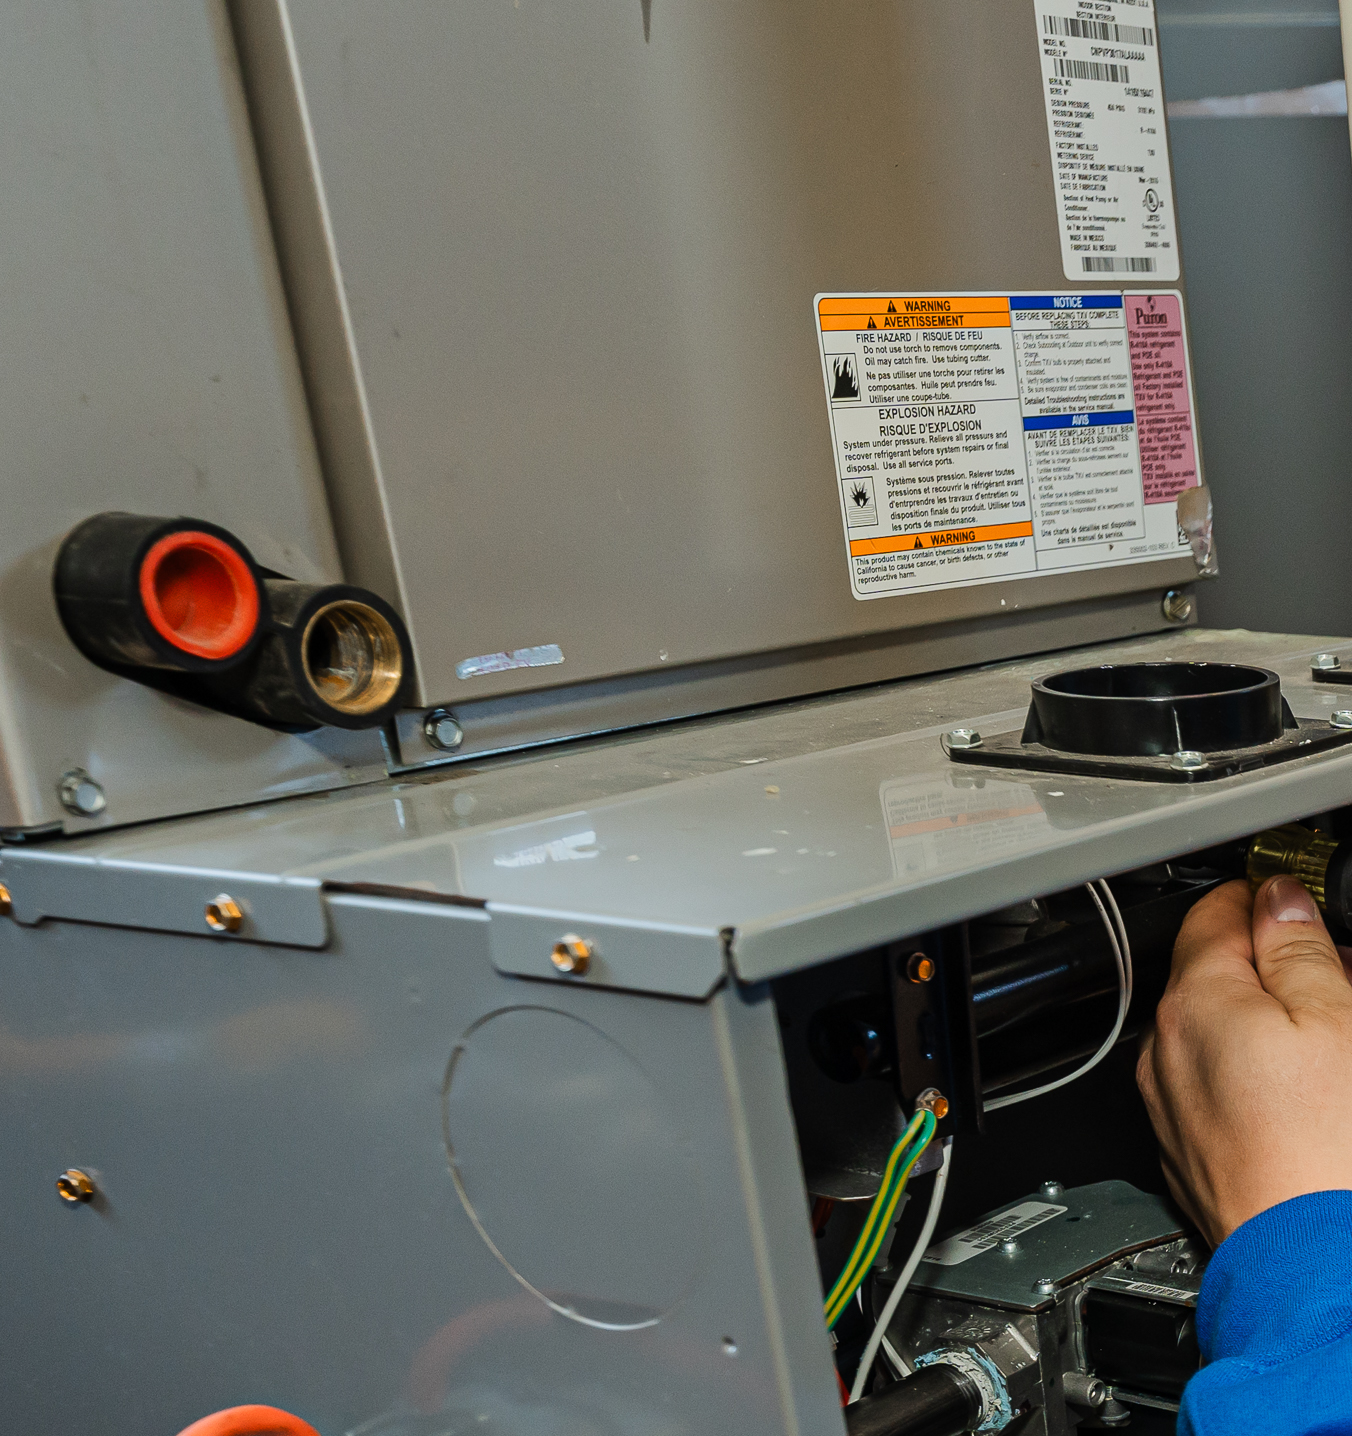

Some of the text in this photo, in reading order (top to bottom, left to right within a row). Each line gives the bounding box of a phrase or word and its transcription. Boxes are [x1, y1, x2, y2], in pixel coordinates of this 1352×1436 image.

[904, 301, 951, 311] WARNING
[1054, 297, 1082, 308] NOTICE
[884, 315, 964, 327] AVERTISSEMENT
[1136, 308, 1167, 324] Puron
[856, 334, 874, 343] FIRE
[878, 333, 911, 342] HAZARD
[923, 332, 952, 341] RISQUE
[955, 331, 965, 340] DE
[968, 331, 983, 340] FEU
[864, 345, 873, 354] Do
[876, 345, 886, 353] not
[904, 344, 922, 353] torch
[924, 344, 931, 352] to
[933, 344, 957, 352] remove
[865, 357, 875, 365] Oil
[877, 358, 891, 367] may
[894, 356, 913, 365] catch
[915, 355, 928, 364] fire.
[932, 355, 945, 363] Use
[947, 354, 968, 365] tubing
[866, 366, 1005, 381] Ne pas utiliser une torche pour retirer les
[868, 379, 997, 392] composantes. Huile peut prendre feu.
[869, 395, 894, 403] Utiliser
[912, 392, 951, 403] coupe-tube.
[879, 404, 976, 420] EXPLOSION HAZARD
[1072, 415, 1089, 425] AVIS
[880, 420, 981, 436] RISQUE D'EXPLOSION
[843, 440, 870, 450] System
[872, 437, 893, 447] under
[895, 436, 927, 447] pressure.
[929, 435, 953, 444] Relieve
[965, 432, 994, 443] pressure
[996, 430, 1007, 439] and
[845, 453, 872, 461] recover
[874, 448, 910, 461] refrigerant
[912, 447, 934, 456] before
[936, 446, 960, 456] system
[962, 443, 985, 453] repairs
[995, 441, 1009, 450] final
[846, 463, 879, 474] disposal.
[883, 461, 896, 470] Use
[909, 458, 933, 468] service
[935, 457, 954, 468] ports.
[886, 475, 916, 487] Système
[918, 475, 935, 483] sous
[937, 472, 967, 484] pression.
[995, 468, 1015, 477] toutes
[888, 488, 921, 499] pressions
[924, 486, 930, 494] et
[932, 484, 962, 494] recouvrir
[964, 482, 969, 491] le
[1007, 478, 1024, 487] avant
[937, 494, 946, 504] les
[948, 492, 973, 502] travaux
[975, 489, 1009, 501] d'entretien
[890, 508, 928, 521] disposition
[930, 505, 948, 516] finale
[951, 504, 959, 513] du
[988, 501, 1010, 511] Utiliser
[1012, 499, 1026, 507] tous
[892, 516, 978, 532] les ports de maintenance.
[931, 531, 975, 546] WARNING
[856, 558, 869, 566] This
[871, 555, 895, 566] product
[897, 555, 910, 563] may
[911, 551, 934, 560] contain
[936, 547, 965, 557] chemicals
[967, 545, 985, 553] known
[995, 542, 1003, 550] the
[1020, 539, 1026, 547] of
[857, 565, 887, 575] California
[897, 562, 914, 571] cause
[948, 555, 961, 564] birth
[994, 550, 1009, 558] other
[858, 571, 916, 585] reproductive harm.
